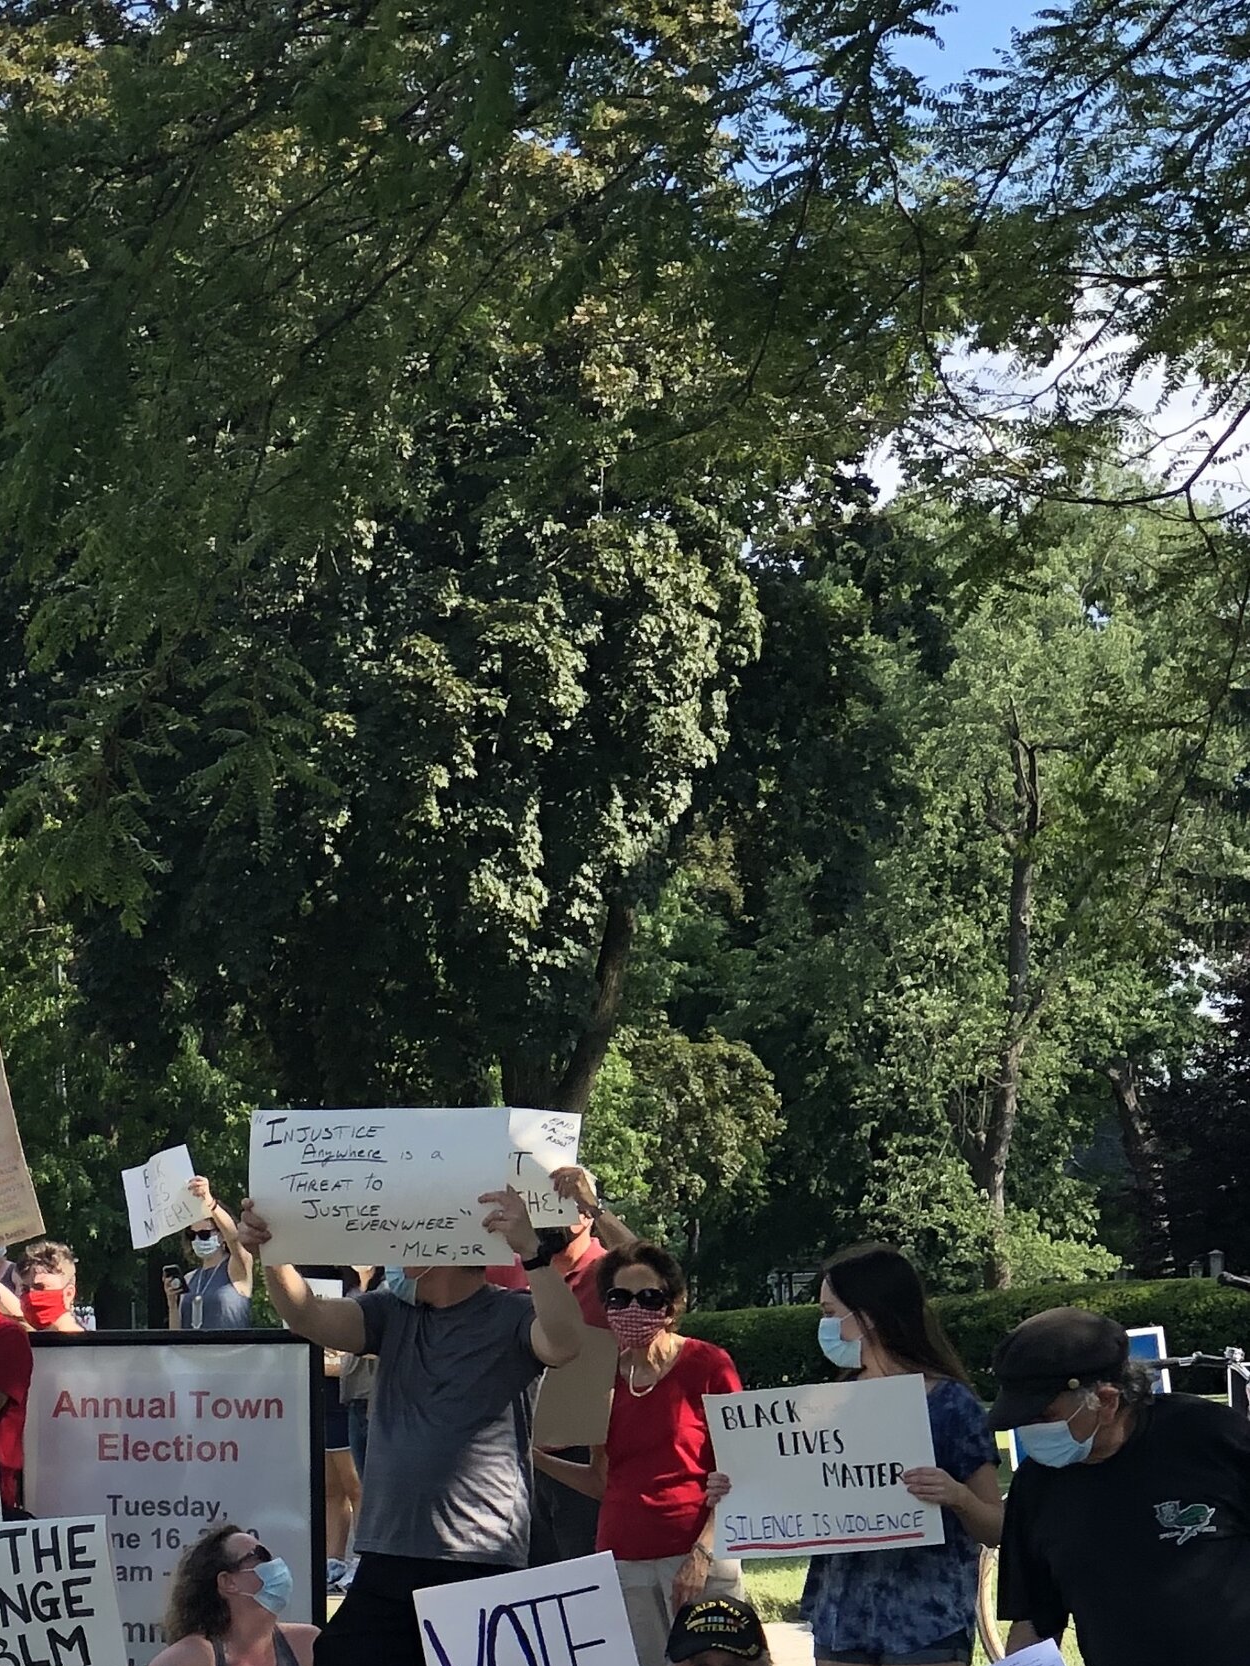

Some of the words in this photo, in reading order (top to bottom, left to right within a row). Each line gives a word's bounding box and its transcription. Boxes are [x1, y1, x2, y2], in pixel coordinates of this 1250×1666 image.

[302, 1143, 384, 1166] Anywhere
[401, 1151, 413, 1161] is
[431, 1151, 444, 1161] a
[280, 1172, 354, 1192] THREAT
[365, 1172, 383, 1191] to
[302, 1199, 381, 1219] JUSTICE
[460, 1244, 486, 1256] JR
[52, 1391, 176, 1420] Annual
[190, 1391, 284, 1420] Town
[720, 1399, 802, 1431] BLACK
[98, 1434, 239, 1463] Election
[777, 1429, 845, 1456] LIVES
[822, 1462, 905, 1489] MATTER
[106, 1494, 228, 1522] Tuesday,
[725, 1514, 804, 1543] SILENCE
[812, 1513, 831, 1537] IS
[836, 1510, 925, 1536] VIOLENCE
[112, 1532, 141, 1549] ne
[718, 1599, 741, 1617] WAR
[693, 1623, 738, 1633] VETERAN
